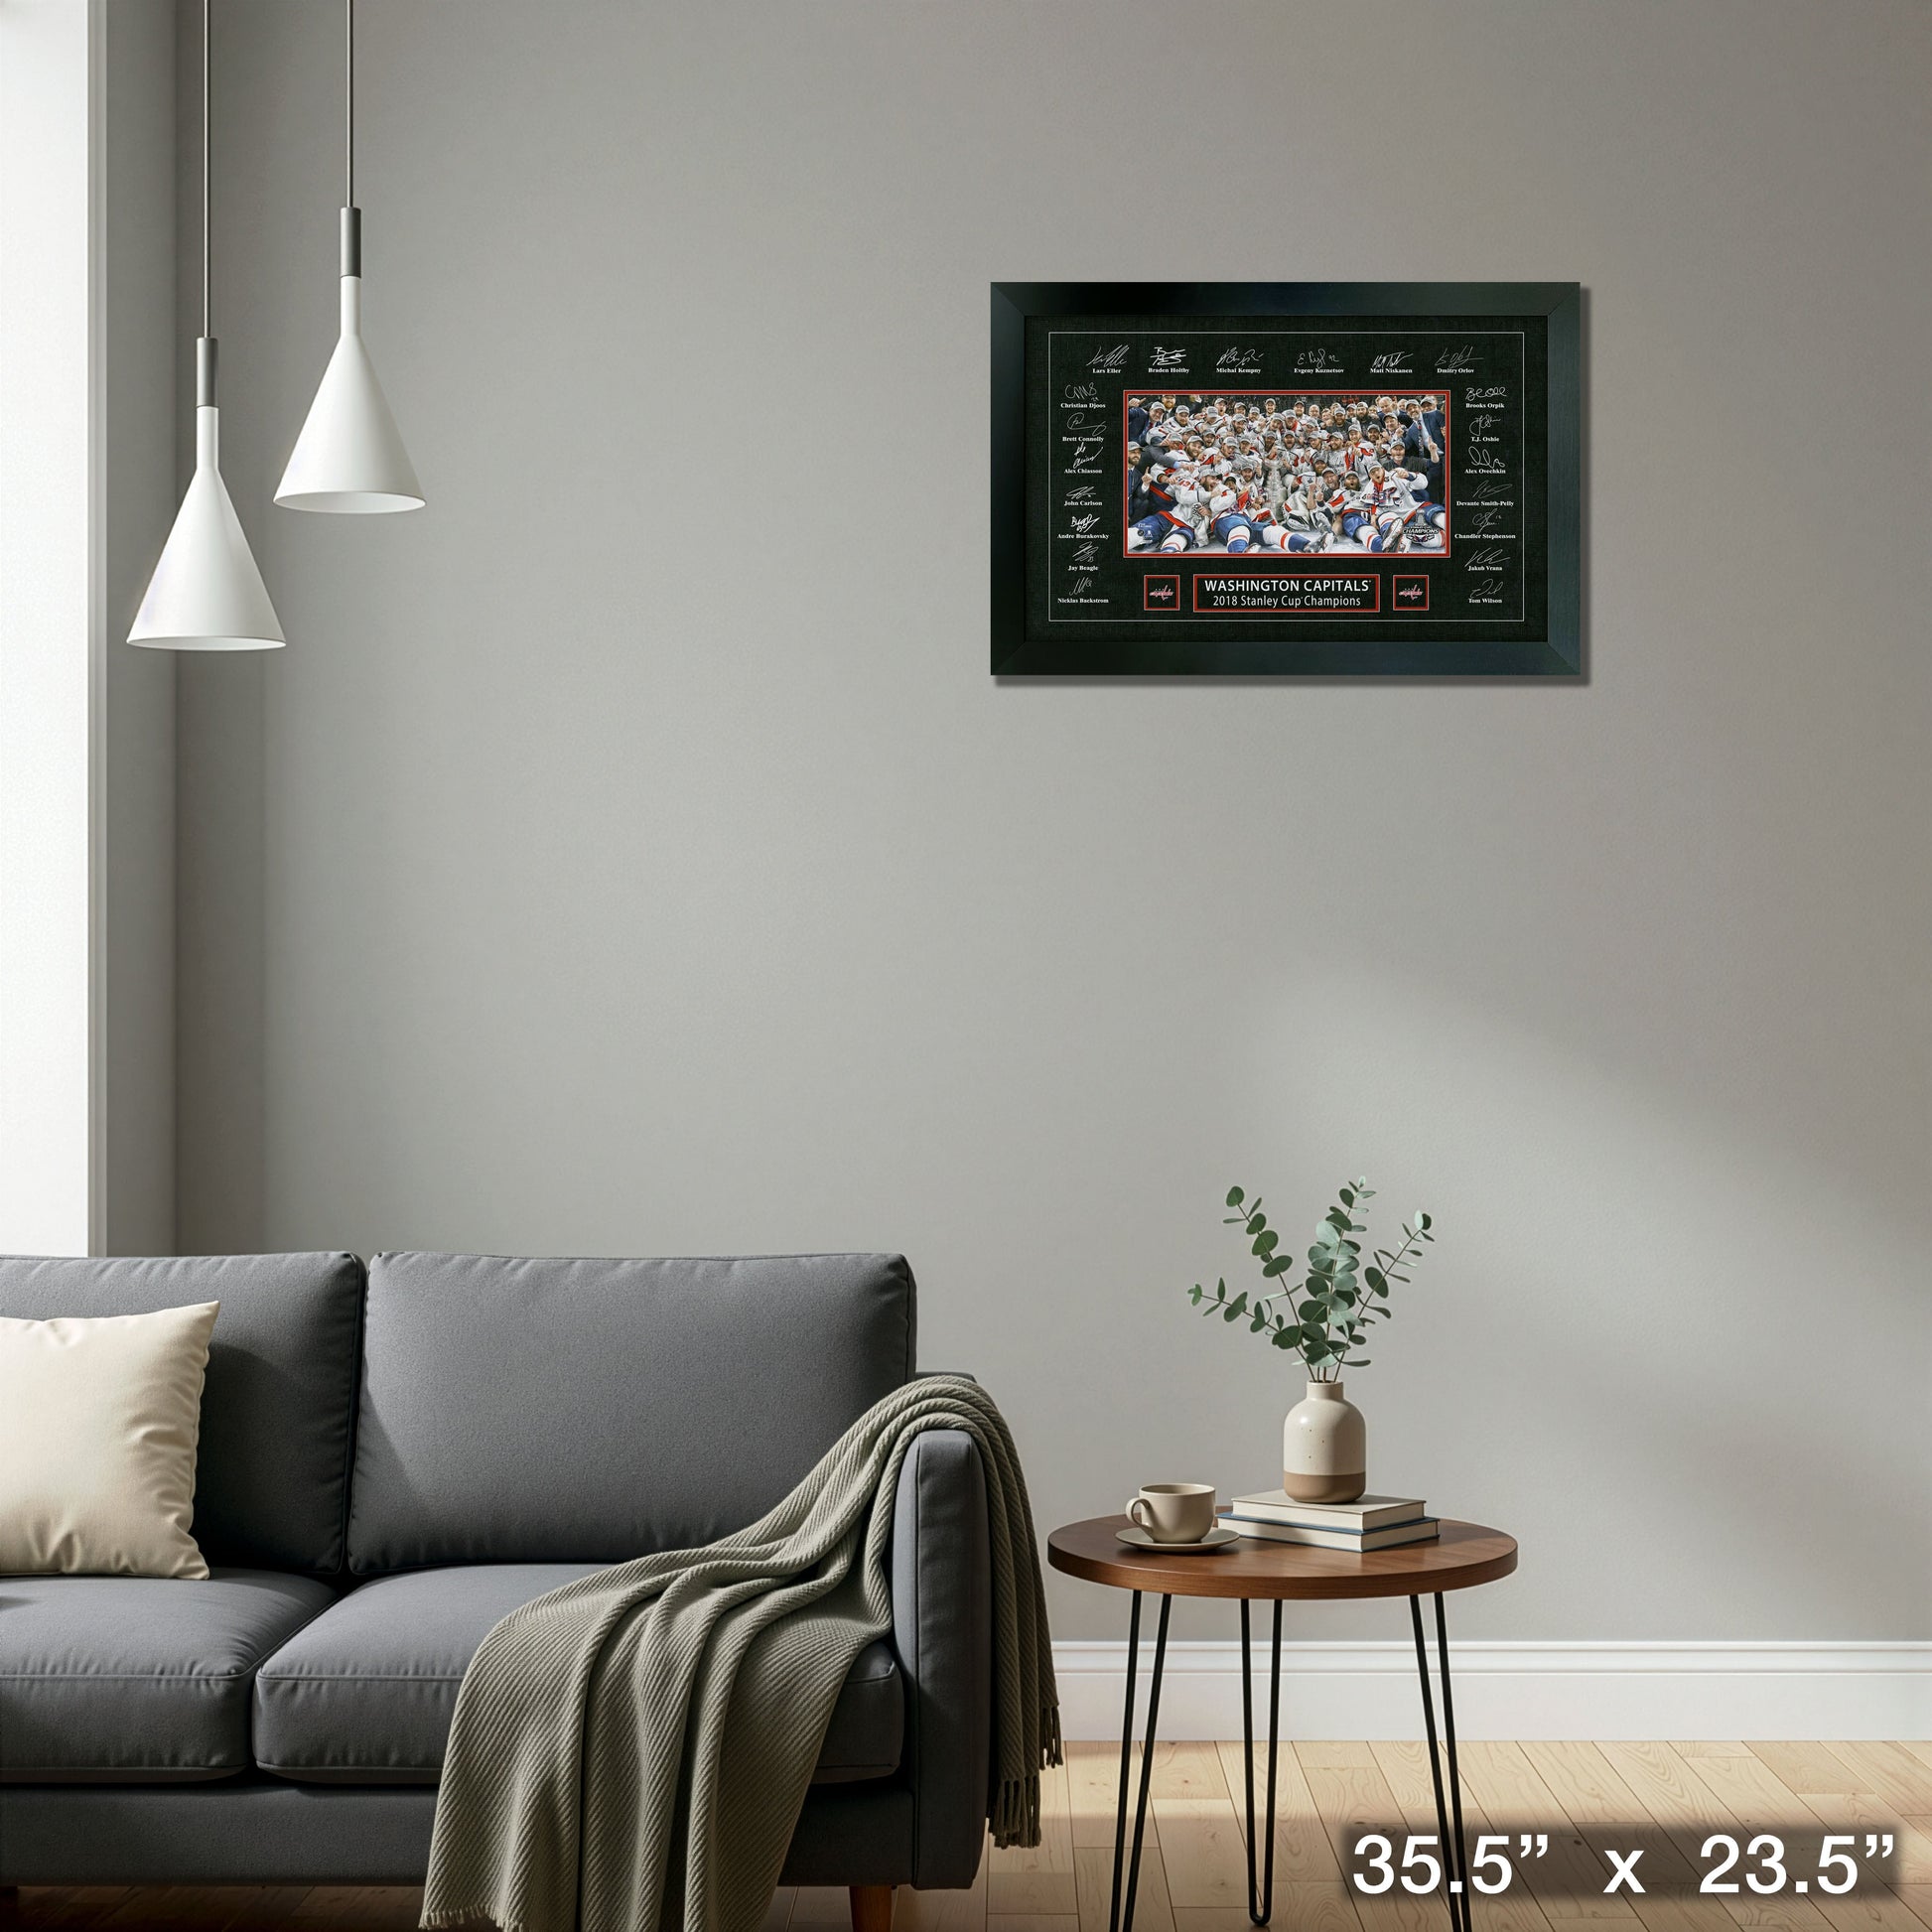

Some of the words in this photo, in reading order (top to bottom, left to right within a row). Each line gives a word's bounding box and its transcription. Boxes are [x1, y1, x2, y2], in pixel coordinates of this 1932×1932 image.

[1204, 579, 1299, 591] WASHINGTON
[1304, 579, 1369, 591] CAPITALS
[1213, 595, 1238, 606] 2018
[1241, 595, 1279, 609] Stanley
[1281, 595, 1302, 608] Cup
[1304, 595, 1361, 608] Champions
